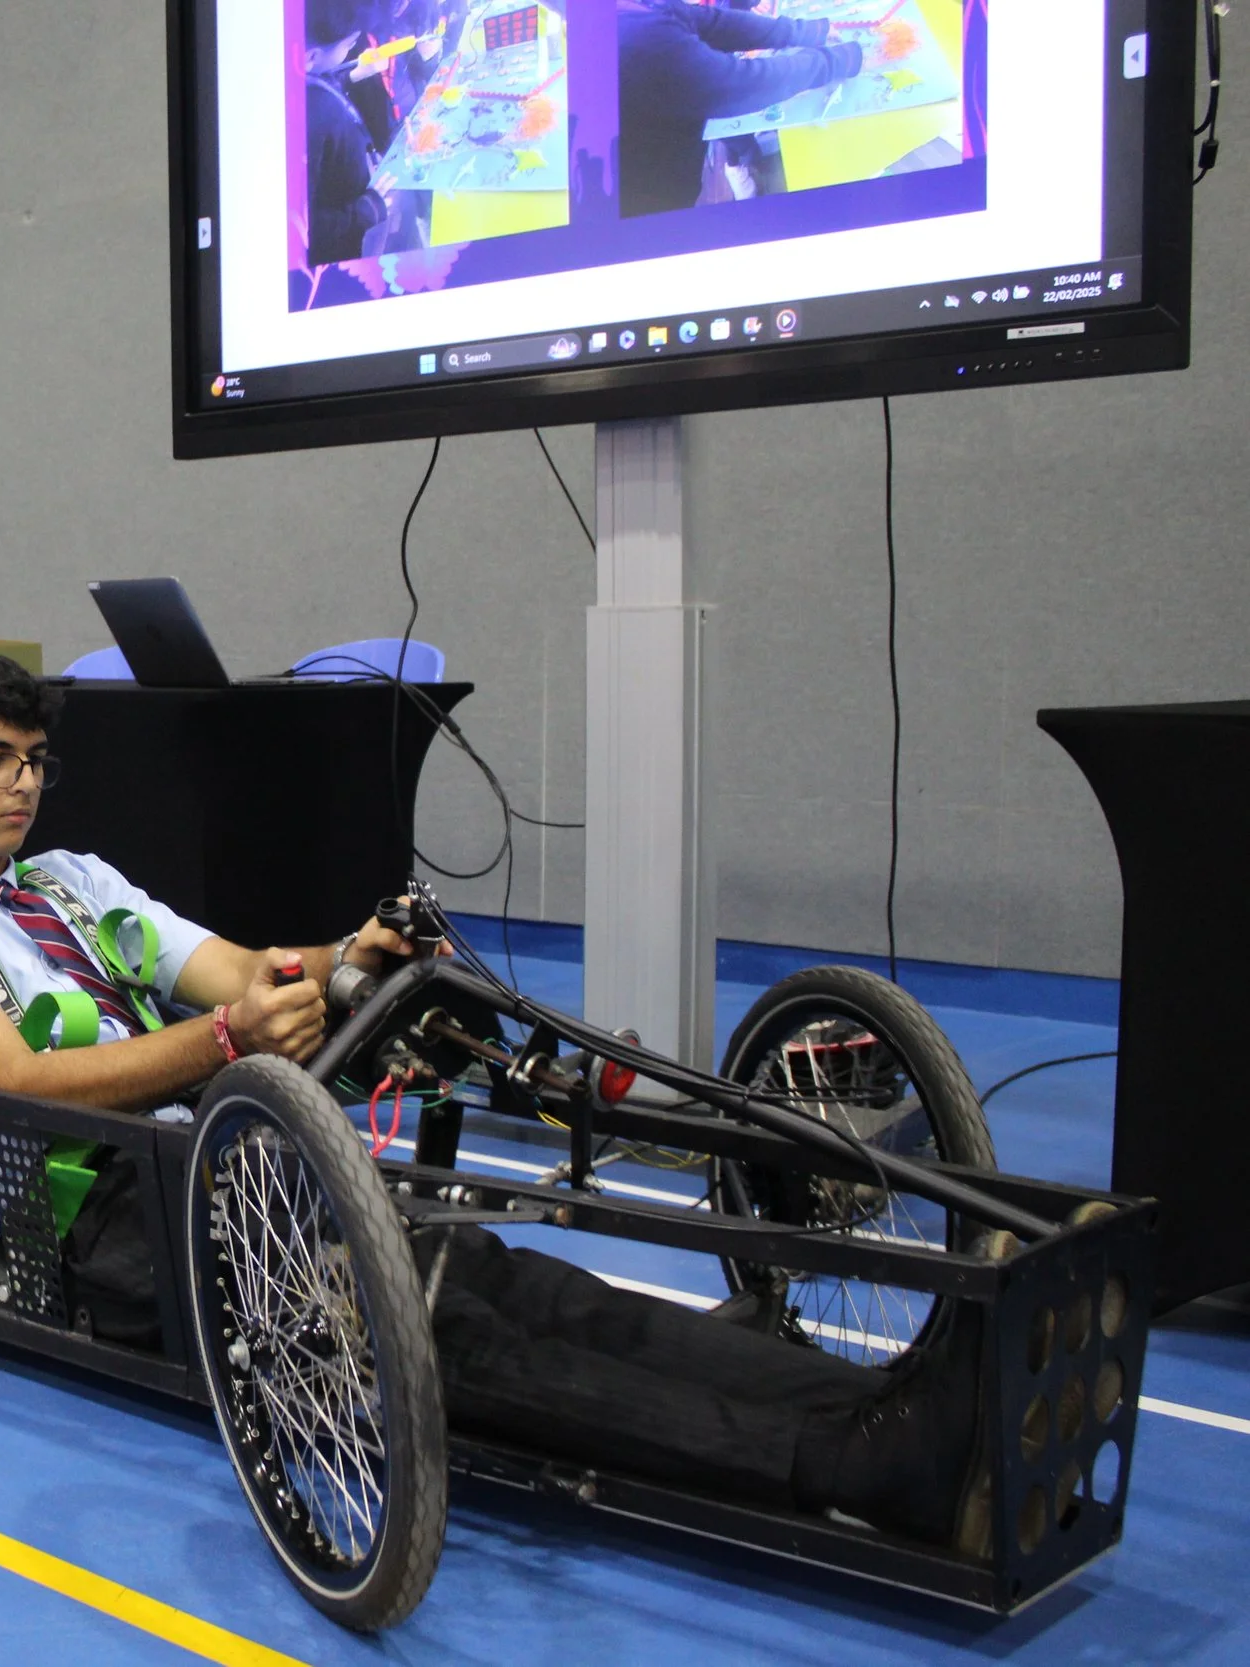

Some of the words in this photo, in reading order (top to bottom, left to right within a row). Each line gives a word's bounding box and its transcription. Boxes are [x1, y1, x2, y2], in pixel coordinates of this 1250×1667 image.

[1053, 273, 1081, 287] 10:40
[1083, 271, 1102, 283] AM
[1043, 286, 1102, 303] 22/02/2025
[463, 352, 492, 365] Search
[226, 389, 245, 399] Sunny
